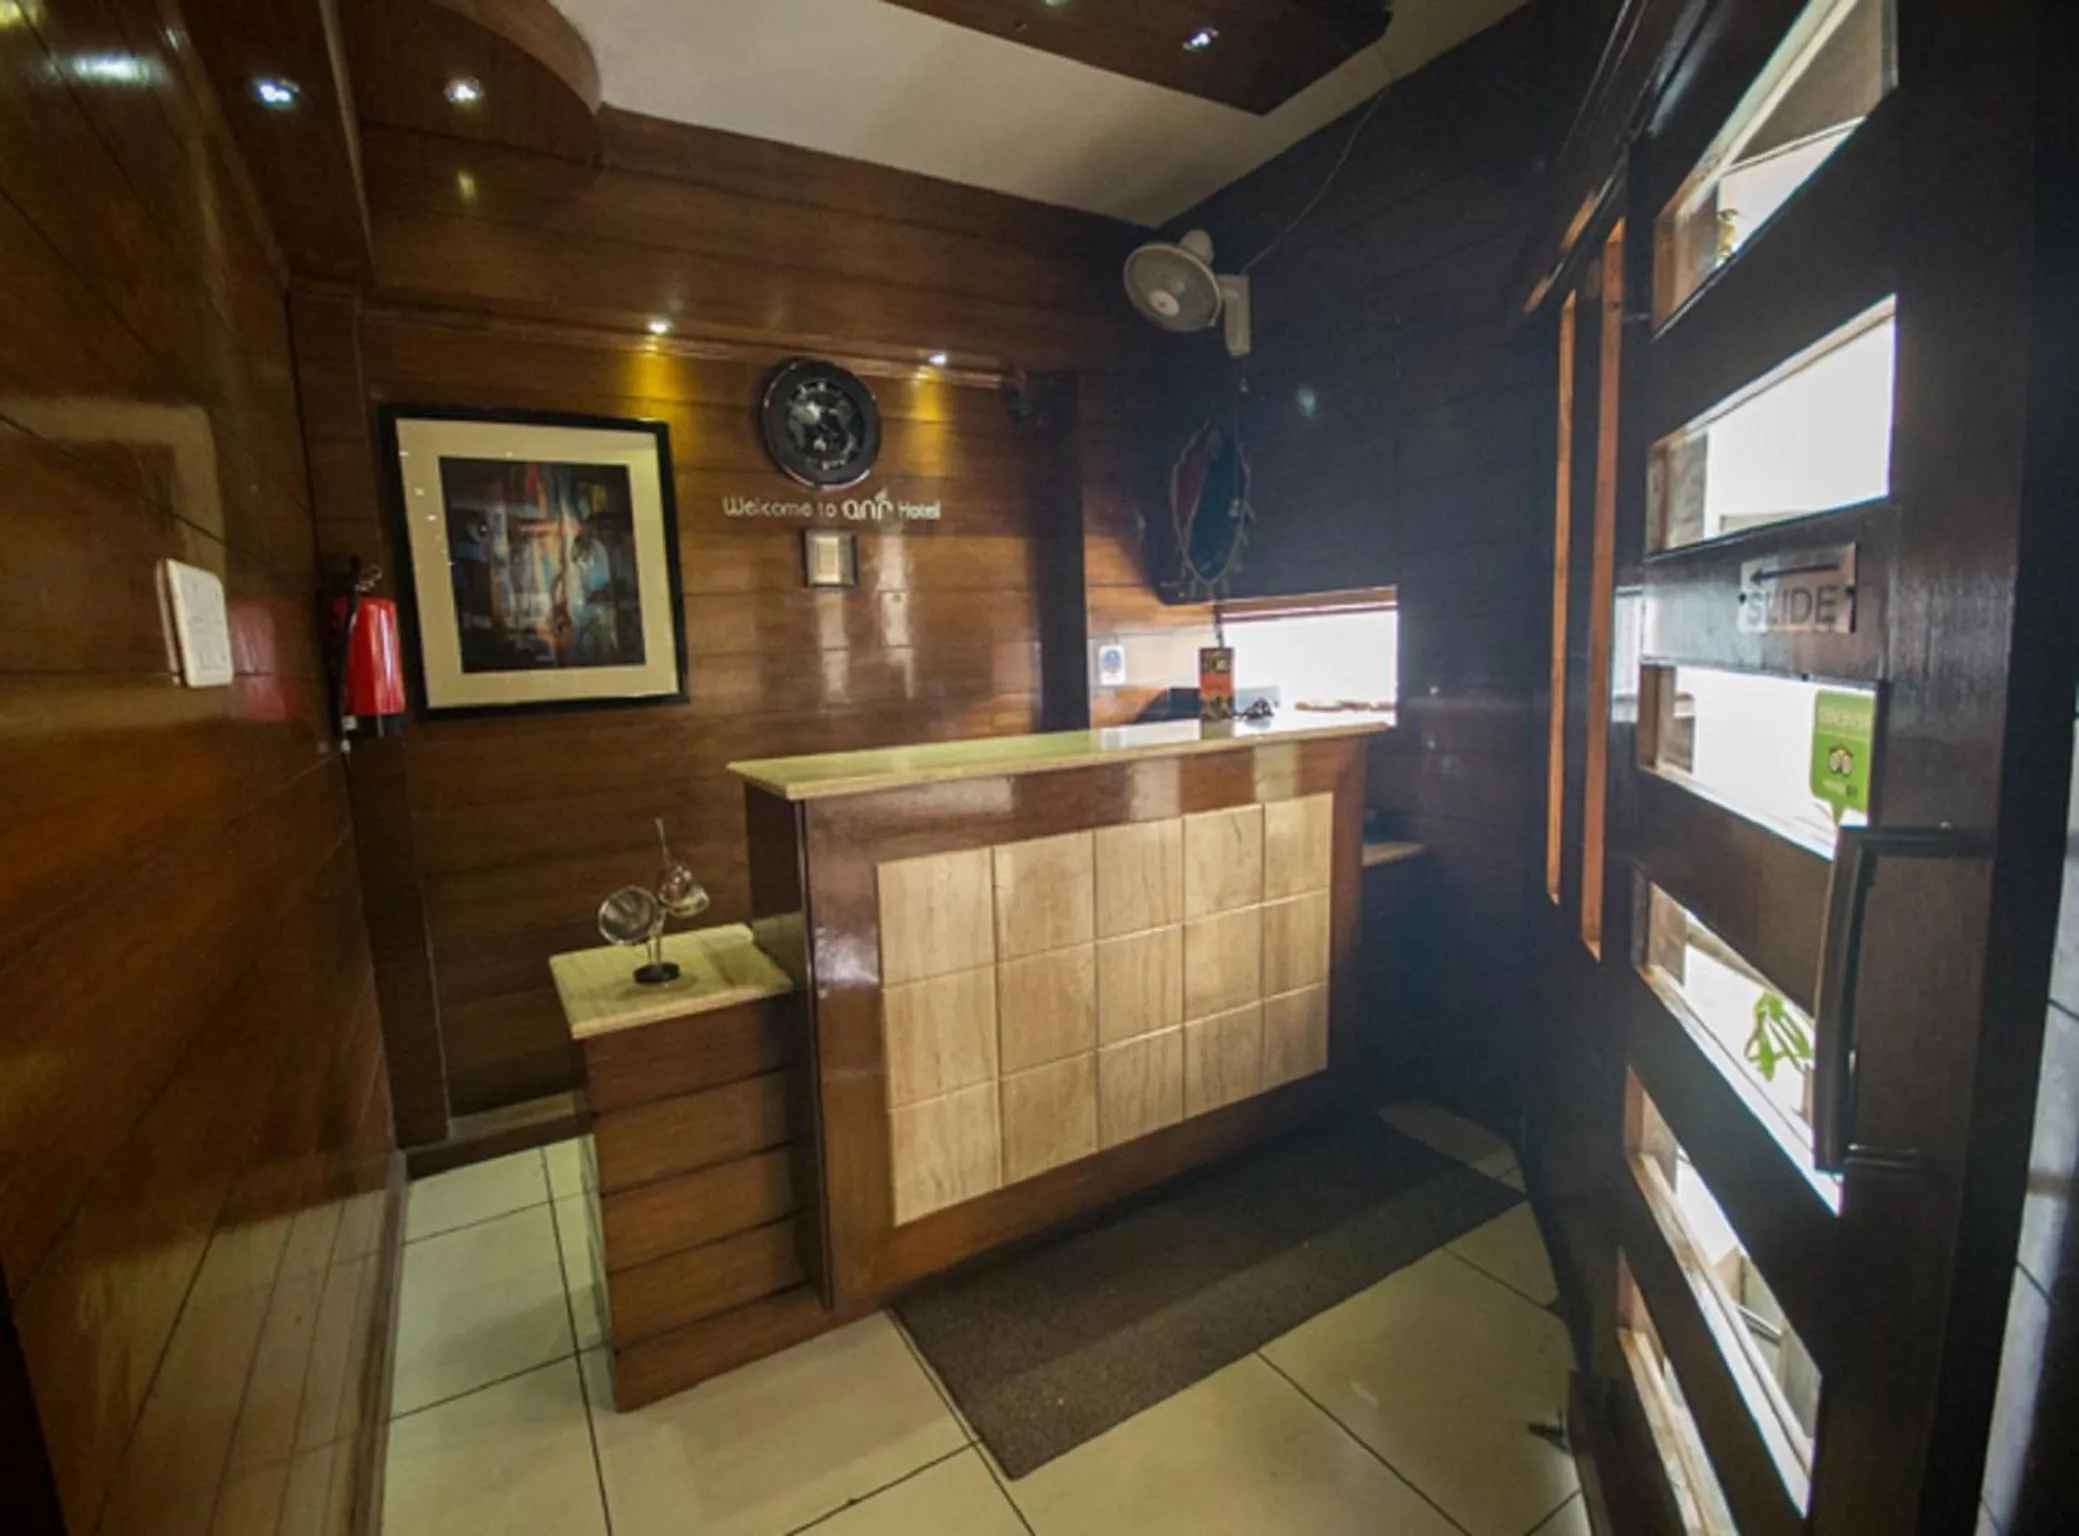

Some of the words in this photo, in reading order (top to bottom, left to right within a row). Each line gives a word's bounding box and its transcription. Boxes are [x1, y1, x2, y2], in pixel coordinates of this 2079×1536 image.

[722, 496, 812, 517] Welcome
[818, 500, 836, 517] to
[1746, 583, 1838, 626] SLIDE
